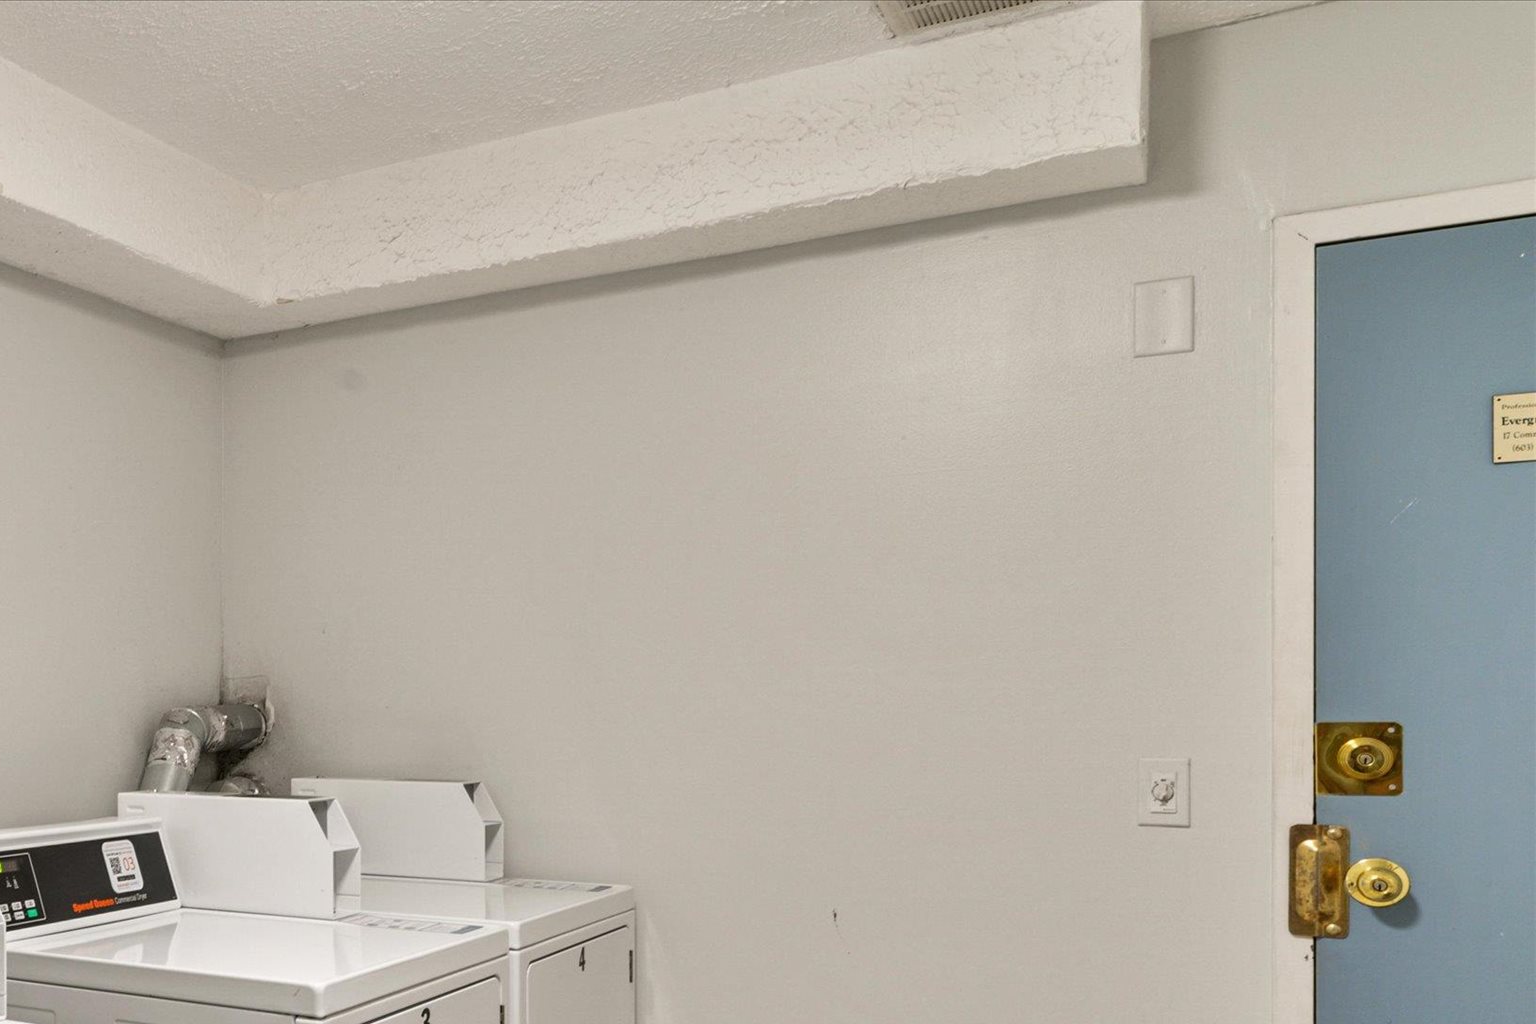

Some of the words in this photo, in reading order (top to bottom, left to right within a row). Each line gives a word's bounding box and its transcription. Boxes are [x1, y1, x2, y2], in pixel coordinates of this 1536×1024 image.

[1512, 444, 1534, 452] (603)
[123, 857, 136, 871] 03
[578, 947, 586, 972] 4
